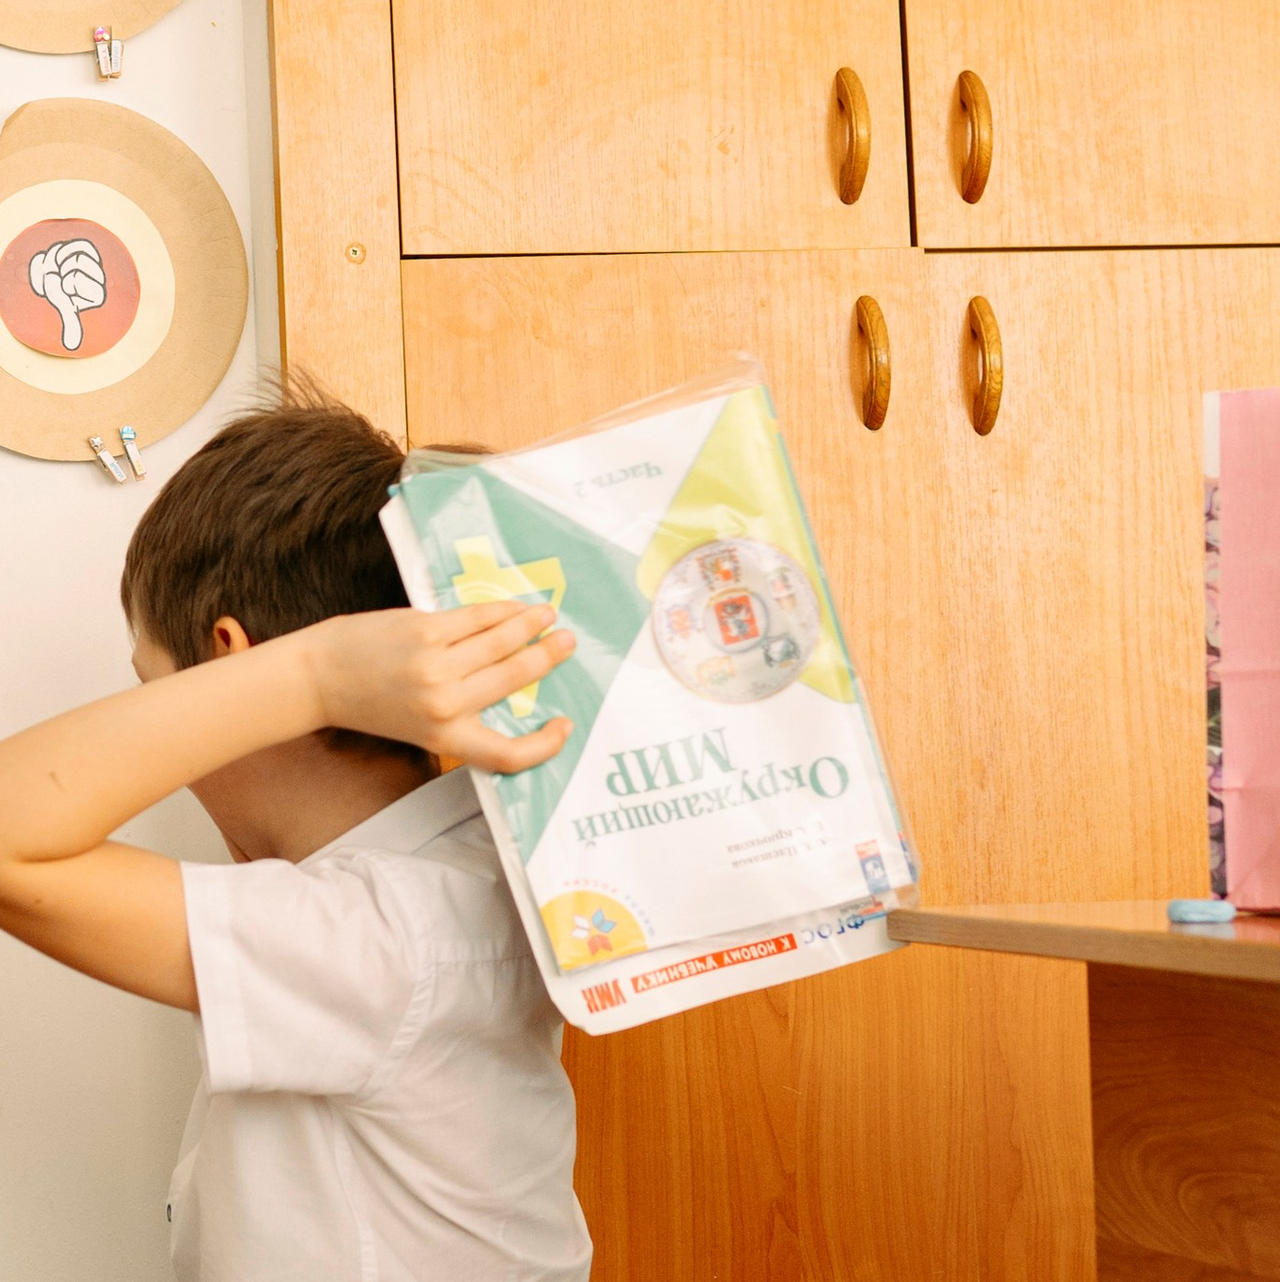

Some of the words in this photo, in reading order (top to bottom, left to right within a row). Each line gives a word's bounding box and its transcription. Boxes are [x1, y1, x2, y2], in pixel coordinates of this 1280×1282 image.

[572, 479, 588, 498] 2
[590, 461, 663, 488] Часть
[605, 726, 740, 797] МИР
[571, 755, 849, 849] Окружающий
[782, 936, 791, 951] К
[800, 914, 866, 944] ФГОС
[723, 942, 777, 965] НОВОМУ
[636, 956, 718, 992] УЧЕБНИКУ
[582, 979, 627, 1014] УМК
